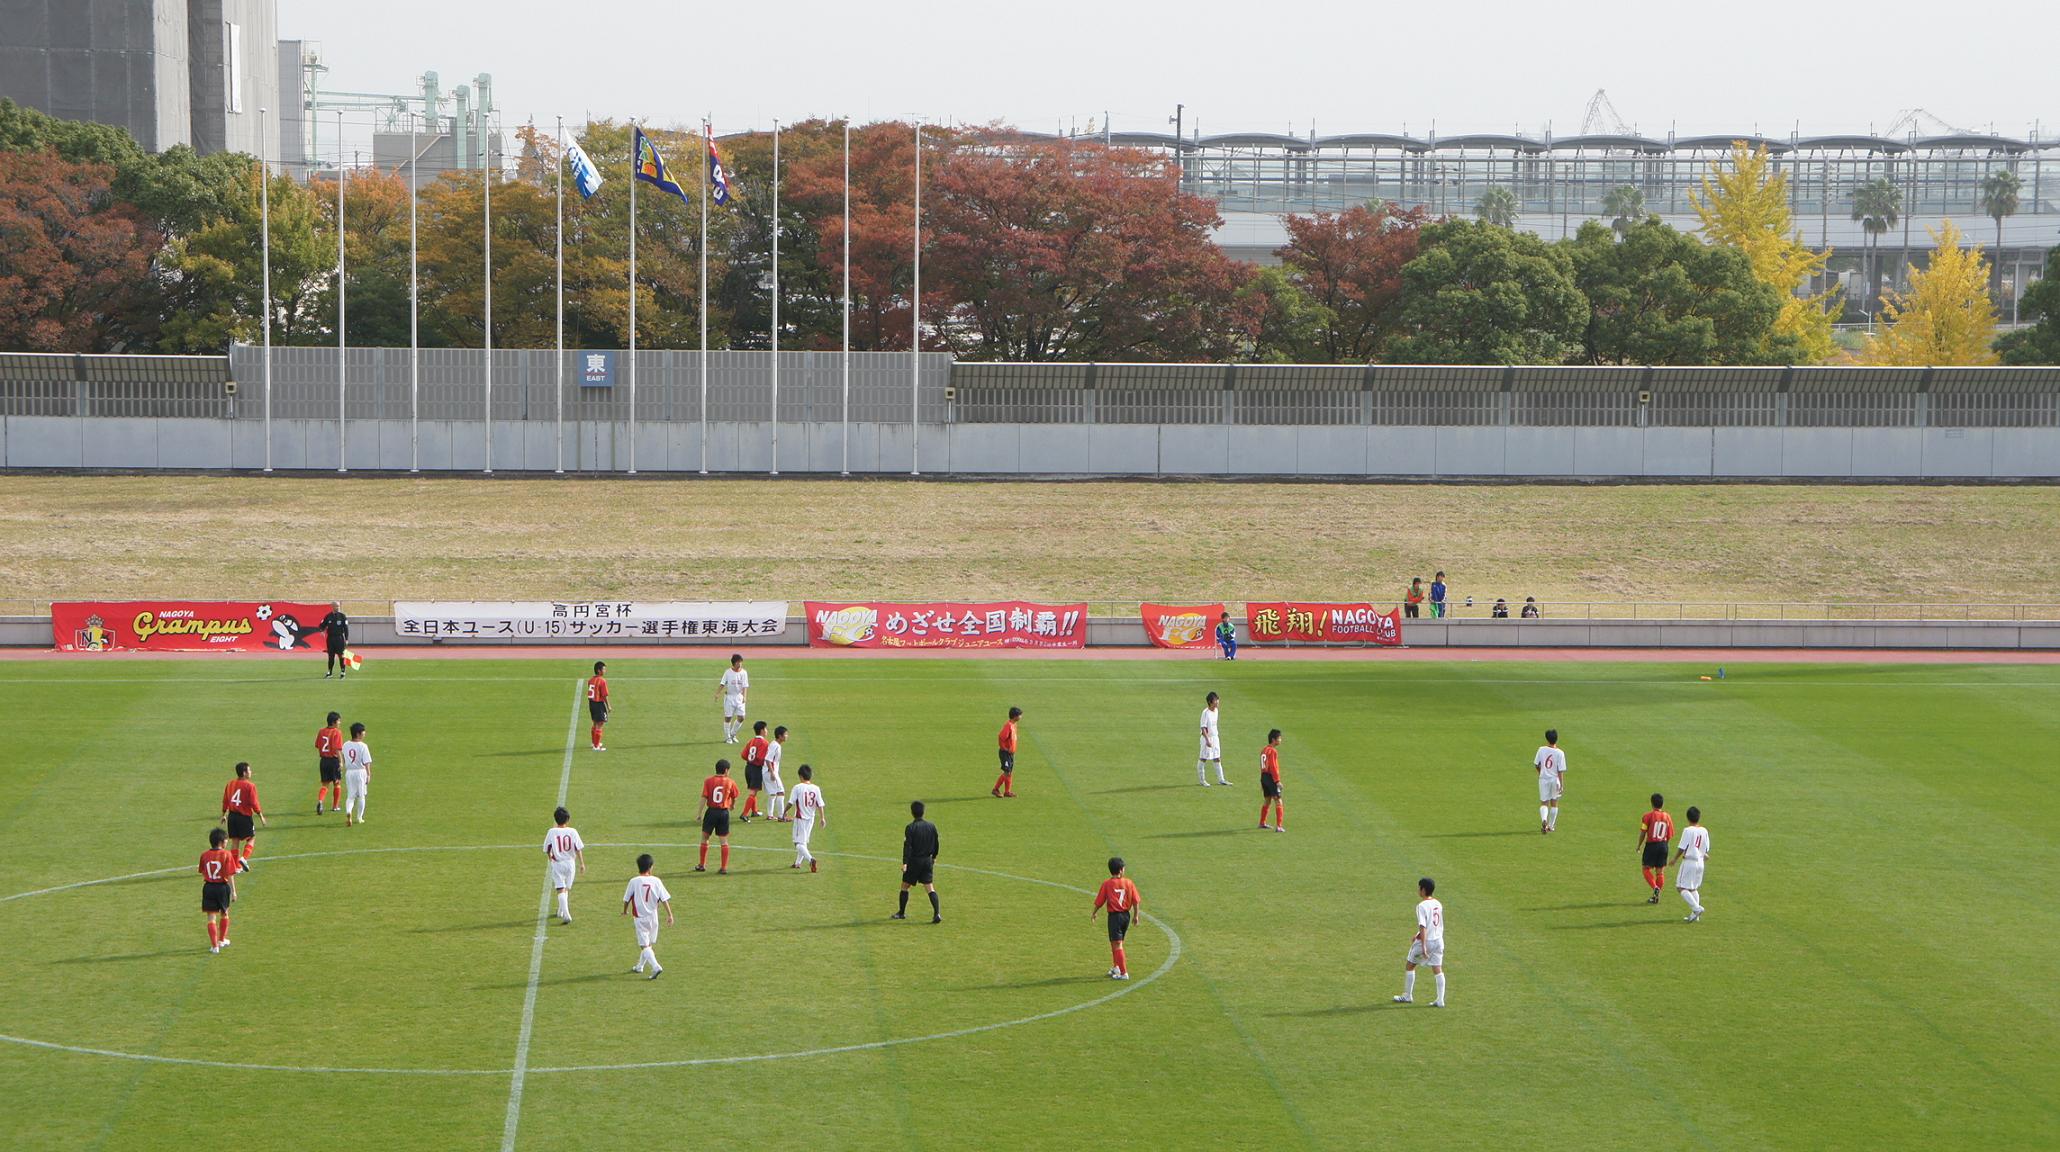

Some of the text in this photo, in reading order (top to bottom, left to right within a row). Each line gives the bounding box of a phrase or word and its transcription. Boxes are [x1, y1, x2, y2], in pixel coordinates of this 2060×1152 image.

[586, 354, 605, 372] 東
[159, 610, 195, 618] NAGOYA
[553, 604, 632, 618] 高円宮杯
[816, 610, 878, 624] NAGOYA
[1332, 609, 1394, 629] NAGOYA
[133, 611, 253, 642] Grampus
[1158, 615, 1207, 627] NAGOYA
[1332, 624, 1374, 634] FOOTBALL
[588, 684, 596, 699] 5
[322, 736, 330, 752] 2
[349, 749, 357, 763] 9
[748, 746, 757, 761] 8
[1545, 754, 1553, 769] 6
[231, 788, 242, 807] 4
[713, 786, 724, 803] 6
[804, 791, 816, 808] 13
[1653, 821, 1668, 840] 10
[556, 835, 572, 853] 10
[206, 860, 222, 879] 12
[642, 884, 651, 903] 7
[1114, 888, 1126, 907] 7
